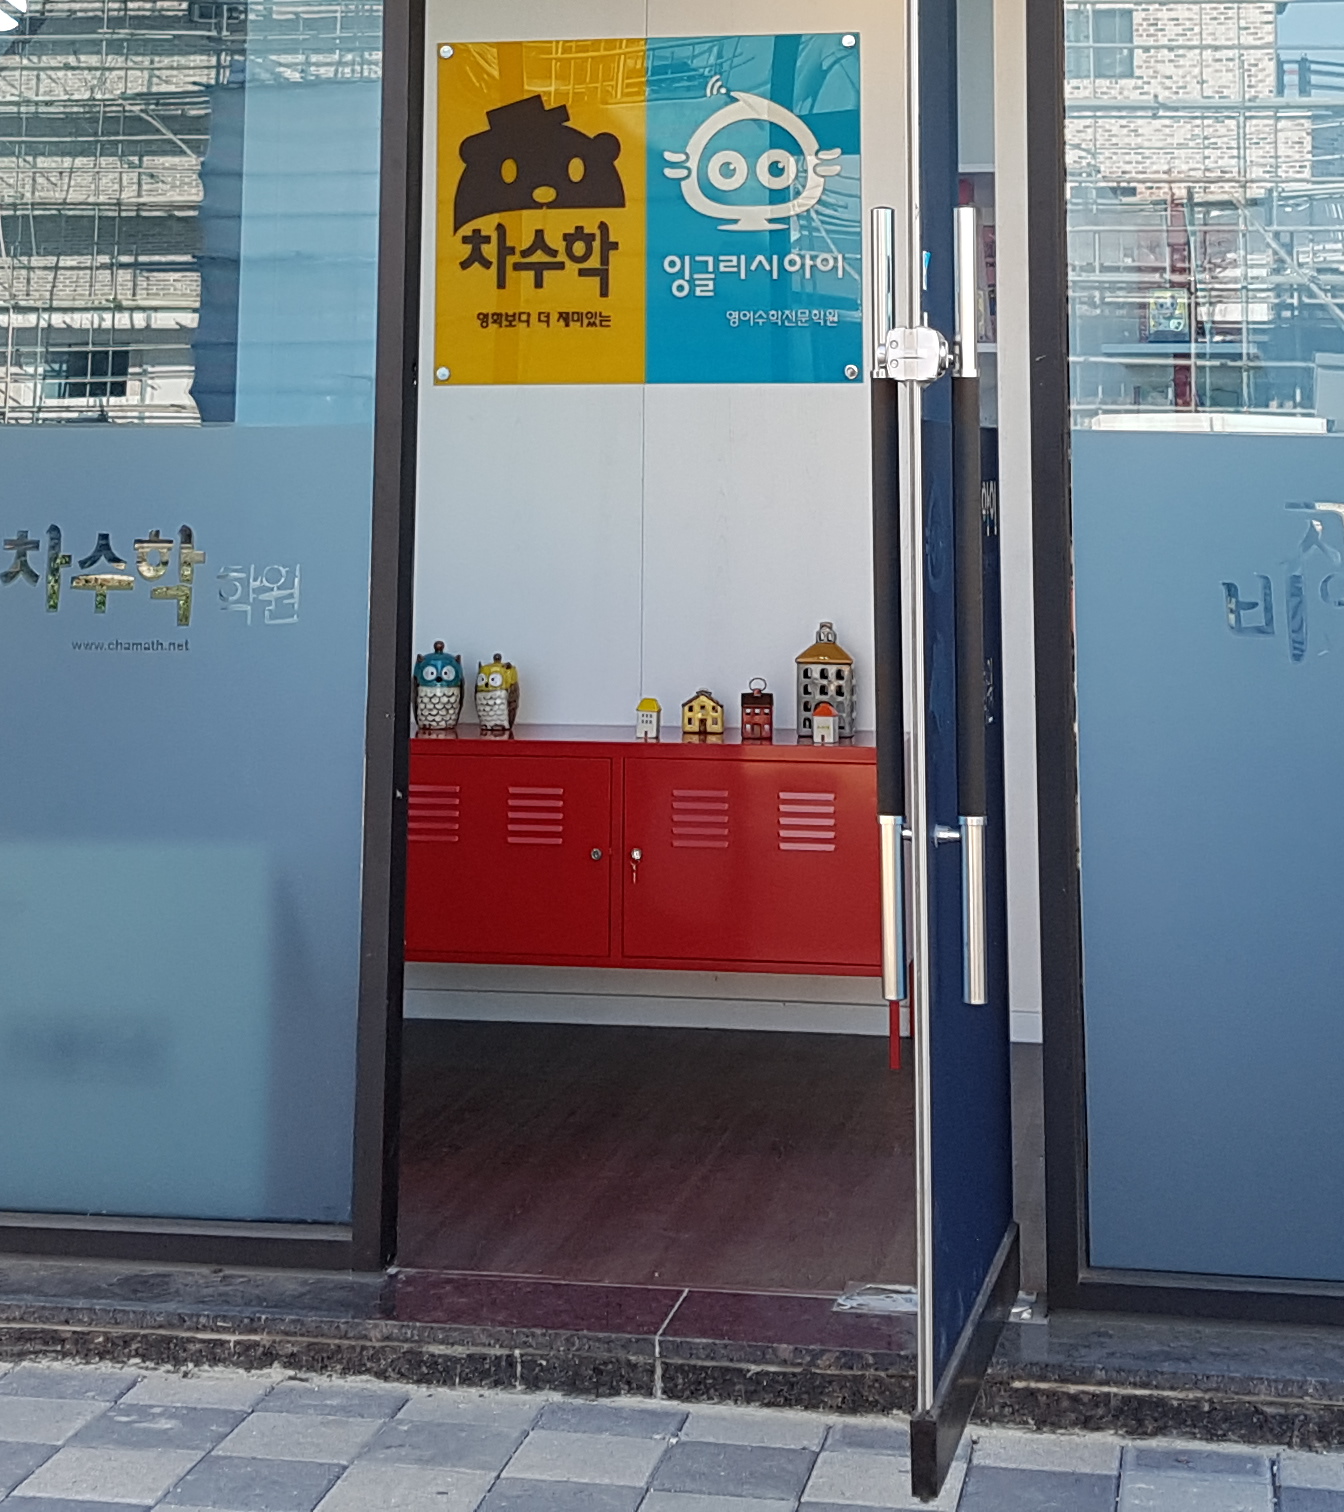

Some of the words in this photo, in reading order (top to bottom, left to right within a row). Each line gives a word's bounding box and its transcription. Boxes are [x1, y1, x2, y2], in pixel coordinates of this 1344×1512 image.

[459, 221, 619, 298] 차수학
[662, 253, 845, 298] 잉글리시아이
[476, 311, 531, 328] 영화보다
[537, 311, 551, 328] 더
[556, 311, 612, 328] 재미있는
[726, 309, 839, 327] 영어수학전문학원
[0, 523, 206, 627] 차수학
[71, 639, 191, 652] www.chamath.net
